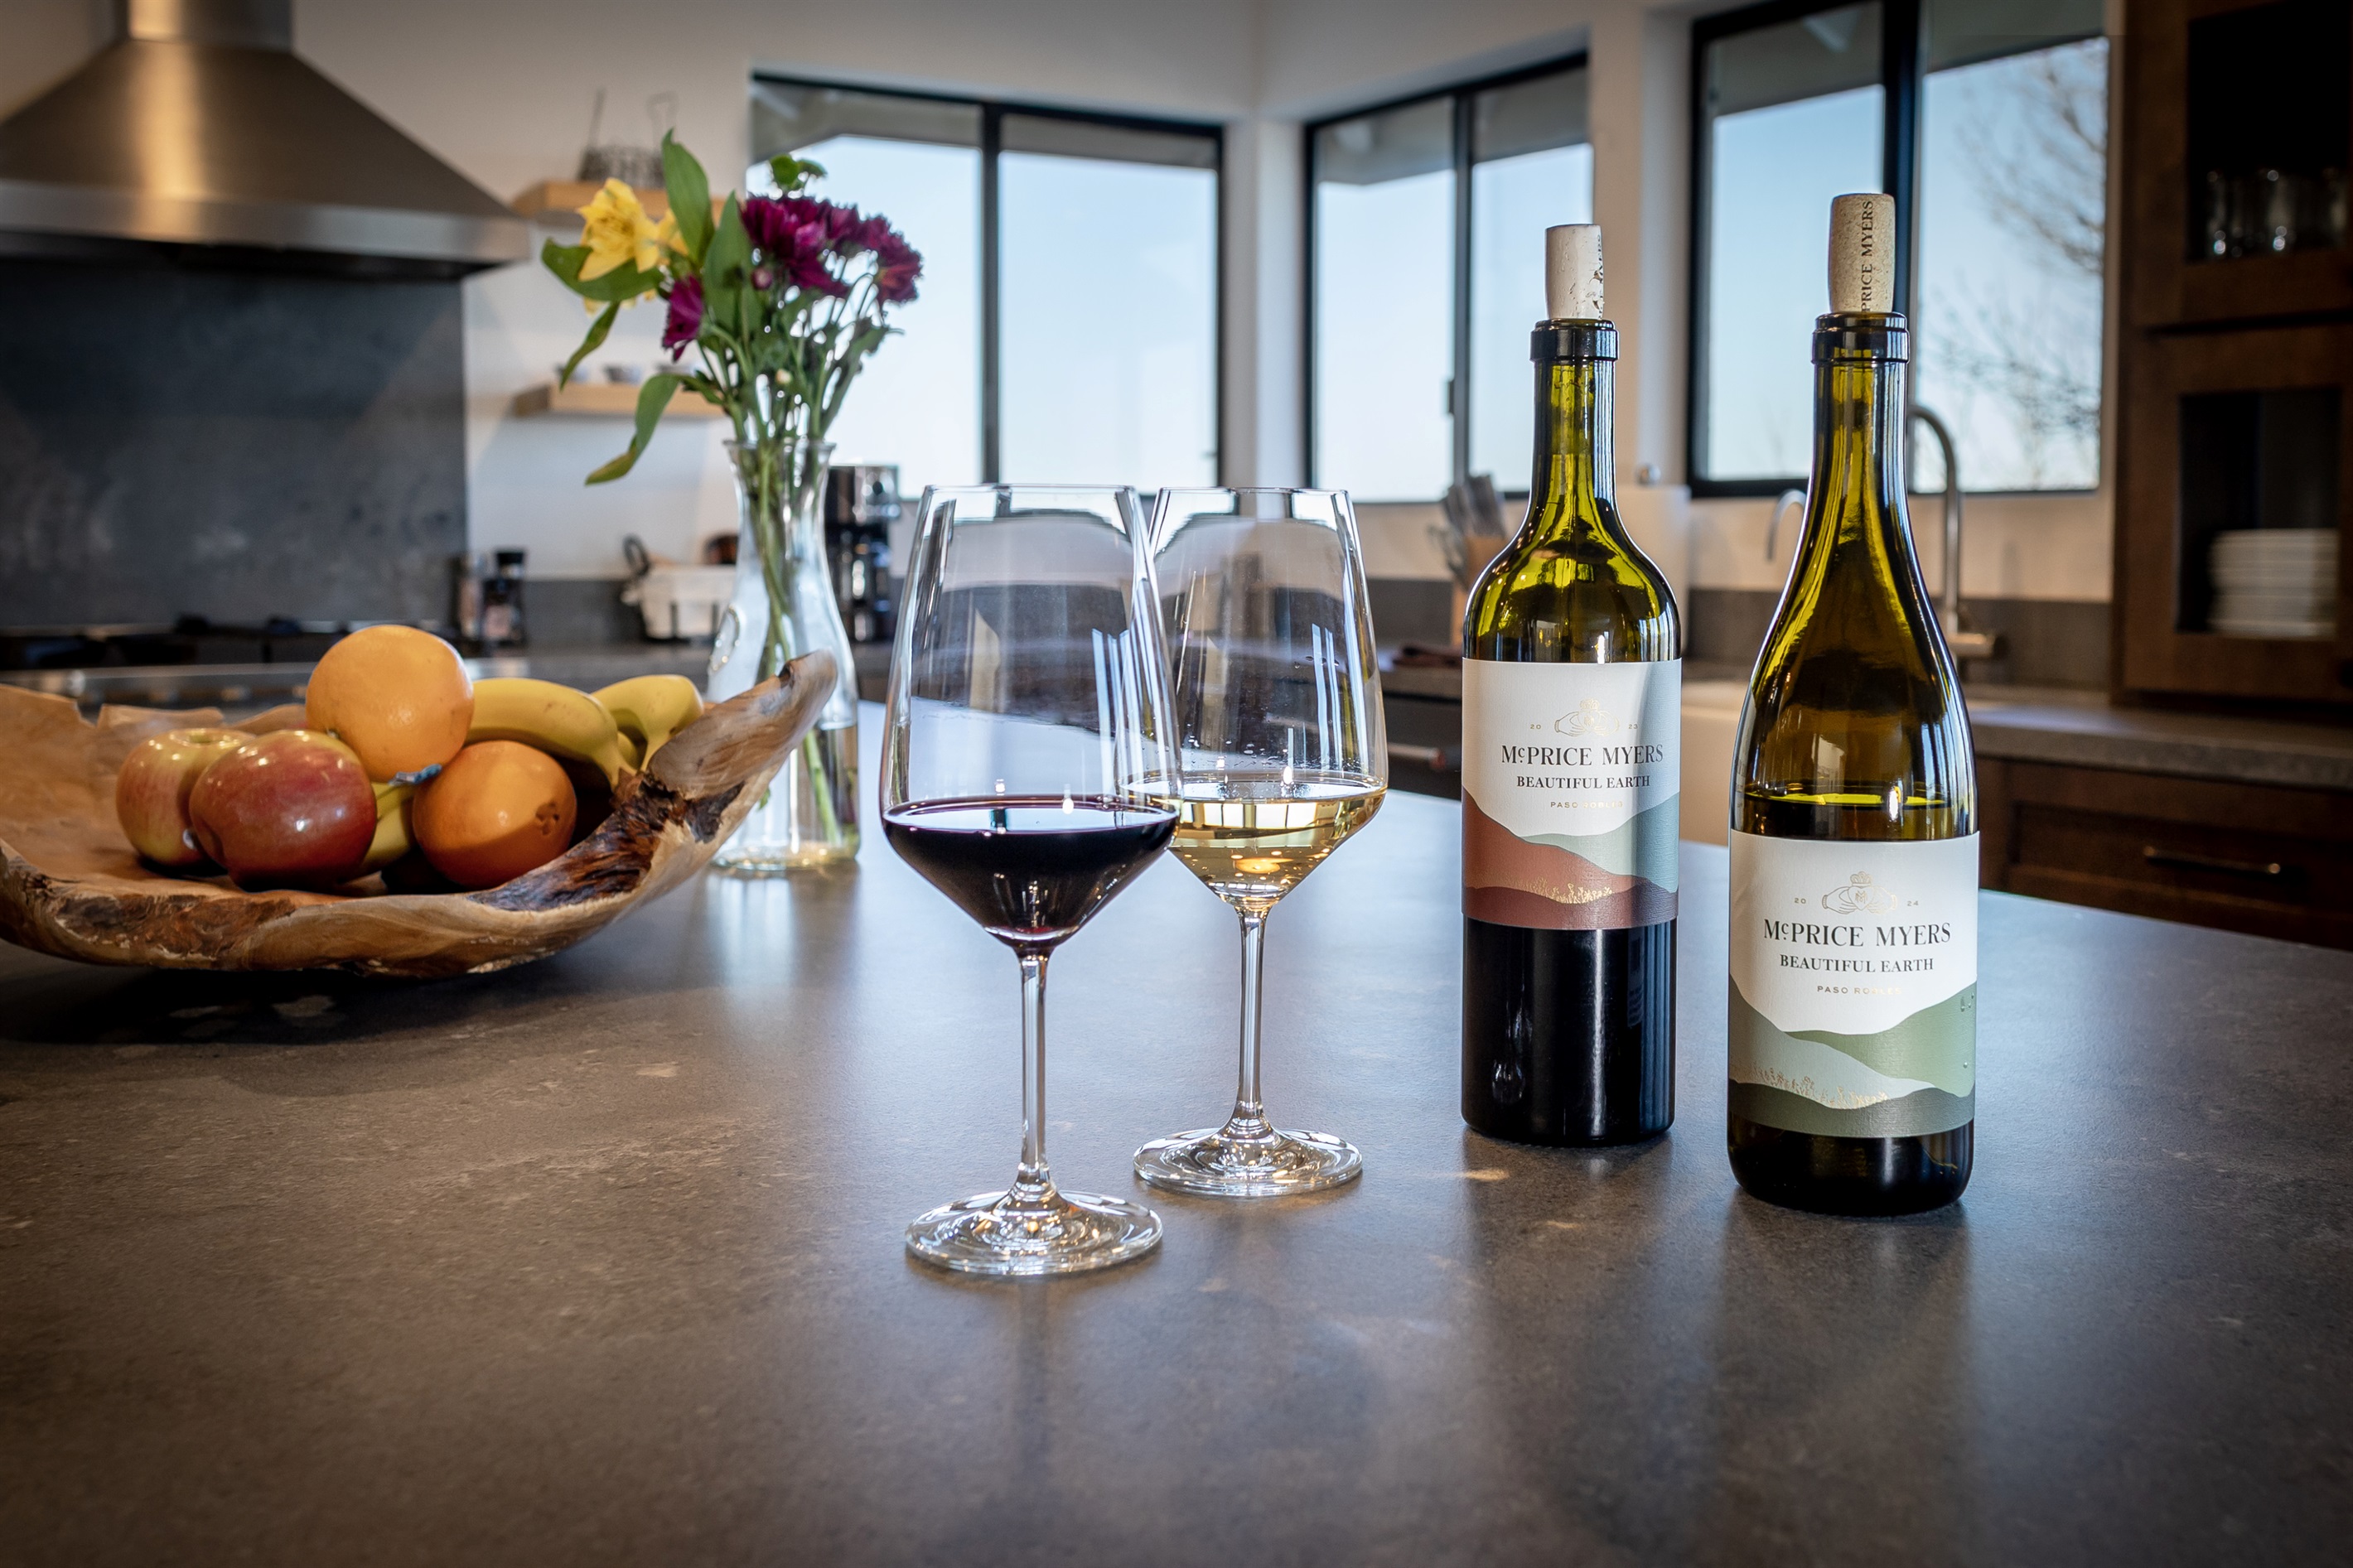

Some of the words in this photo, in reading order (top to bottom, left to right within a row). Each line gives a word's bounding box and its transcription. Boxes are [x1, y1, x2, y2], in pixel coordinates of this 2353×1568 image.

[1861, 200, 1873, 257] MYERS
[1861, 263, 1872, 312] PRICE
[1501, 745, 1592, 766] McPRICE
[1602, 744, 1664, 765] MYERS
[1517, 775, 1602, 789] BEAUTIFUL
[1607, 775, 1650, 788] EARTH
[1763, 919, 1864, 947] McPRICE
[1876, 922, 1951, 947] MYERS
[1780, 954, 1876, 972] BEAUTIFUL
[1881, 958, 1934, 972] EARTH
[1817, 985, 1848, 994] PASO
